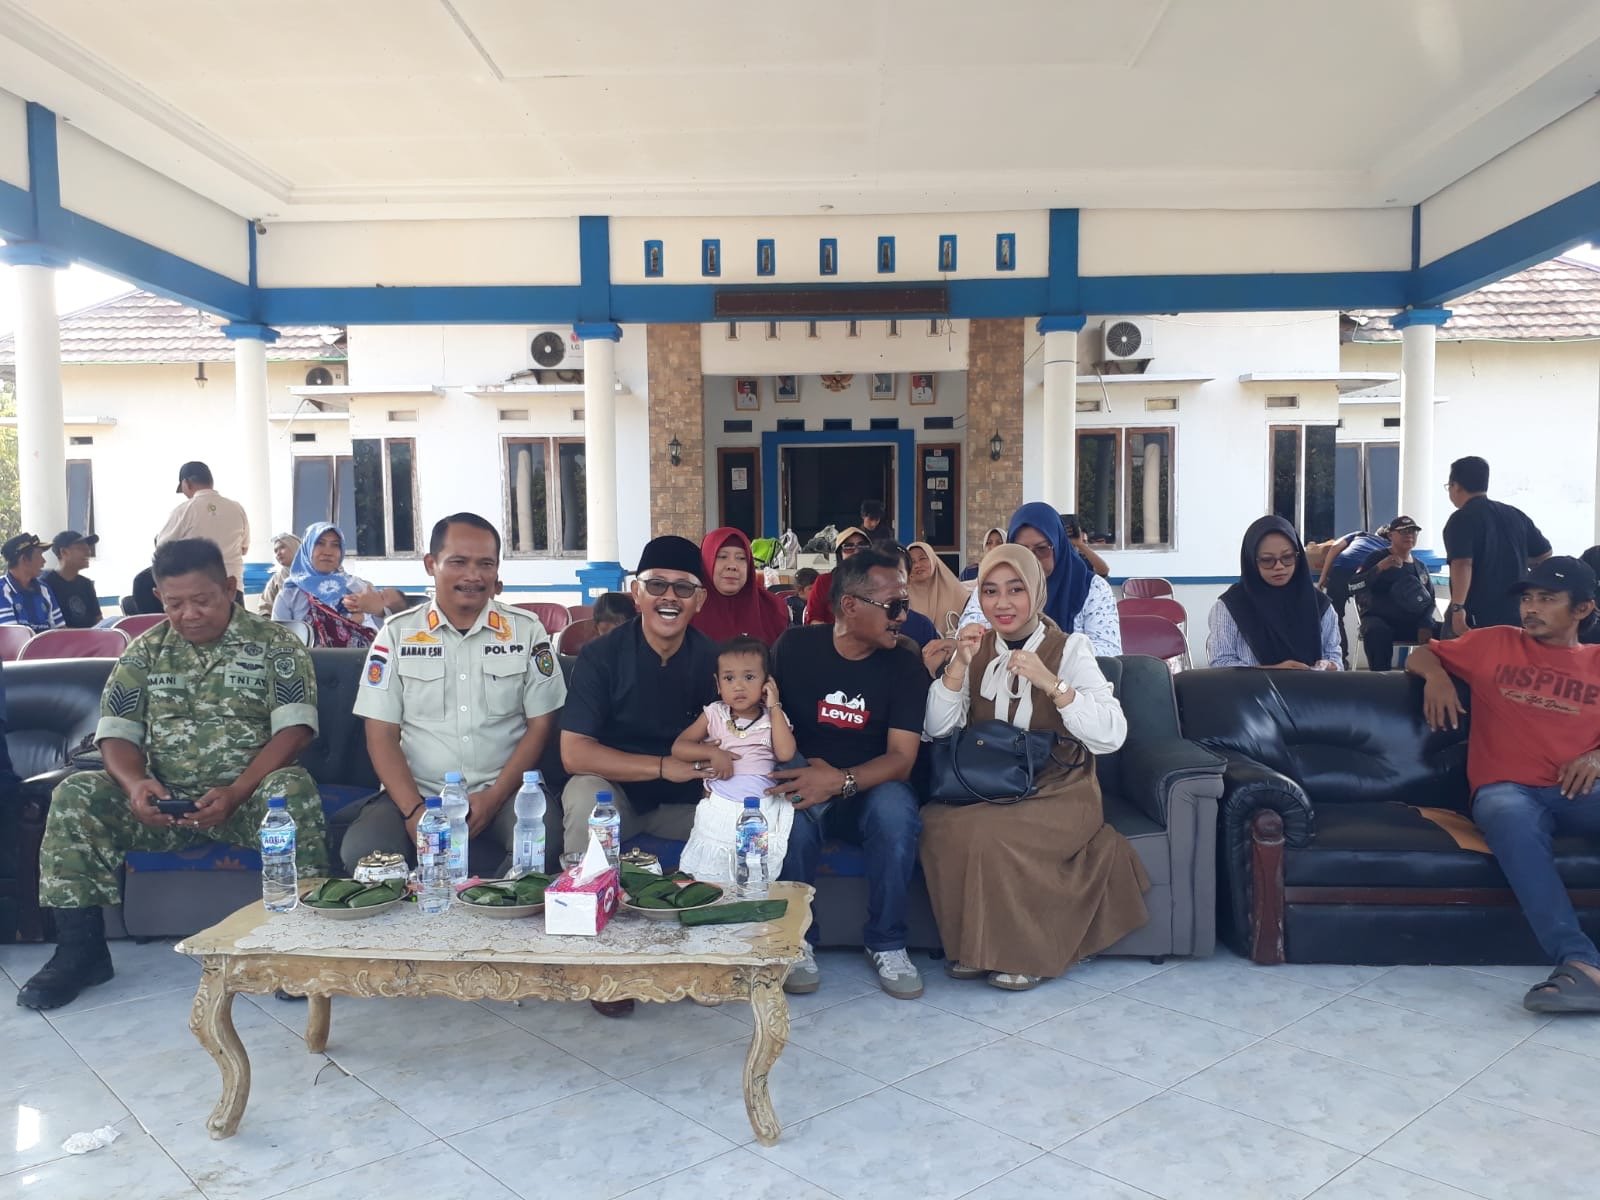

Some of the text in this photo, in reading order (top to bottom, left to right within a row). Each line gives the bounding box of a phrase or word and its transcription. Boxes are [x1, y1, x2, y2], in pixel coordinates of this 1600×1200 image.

[570, 343, 580, 351] LG
[484, 645, 507, 655] POL
[509, 644, 524, 654] PP
[228, 674, 250, 685] TNI
[1495, 663, 1600, 705] INSPIRE
